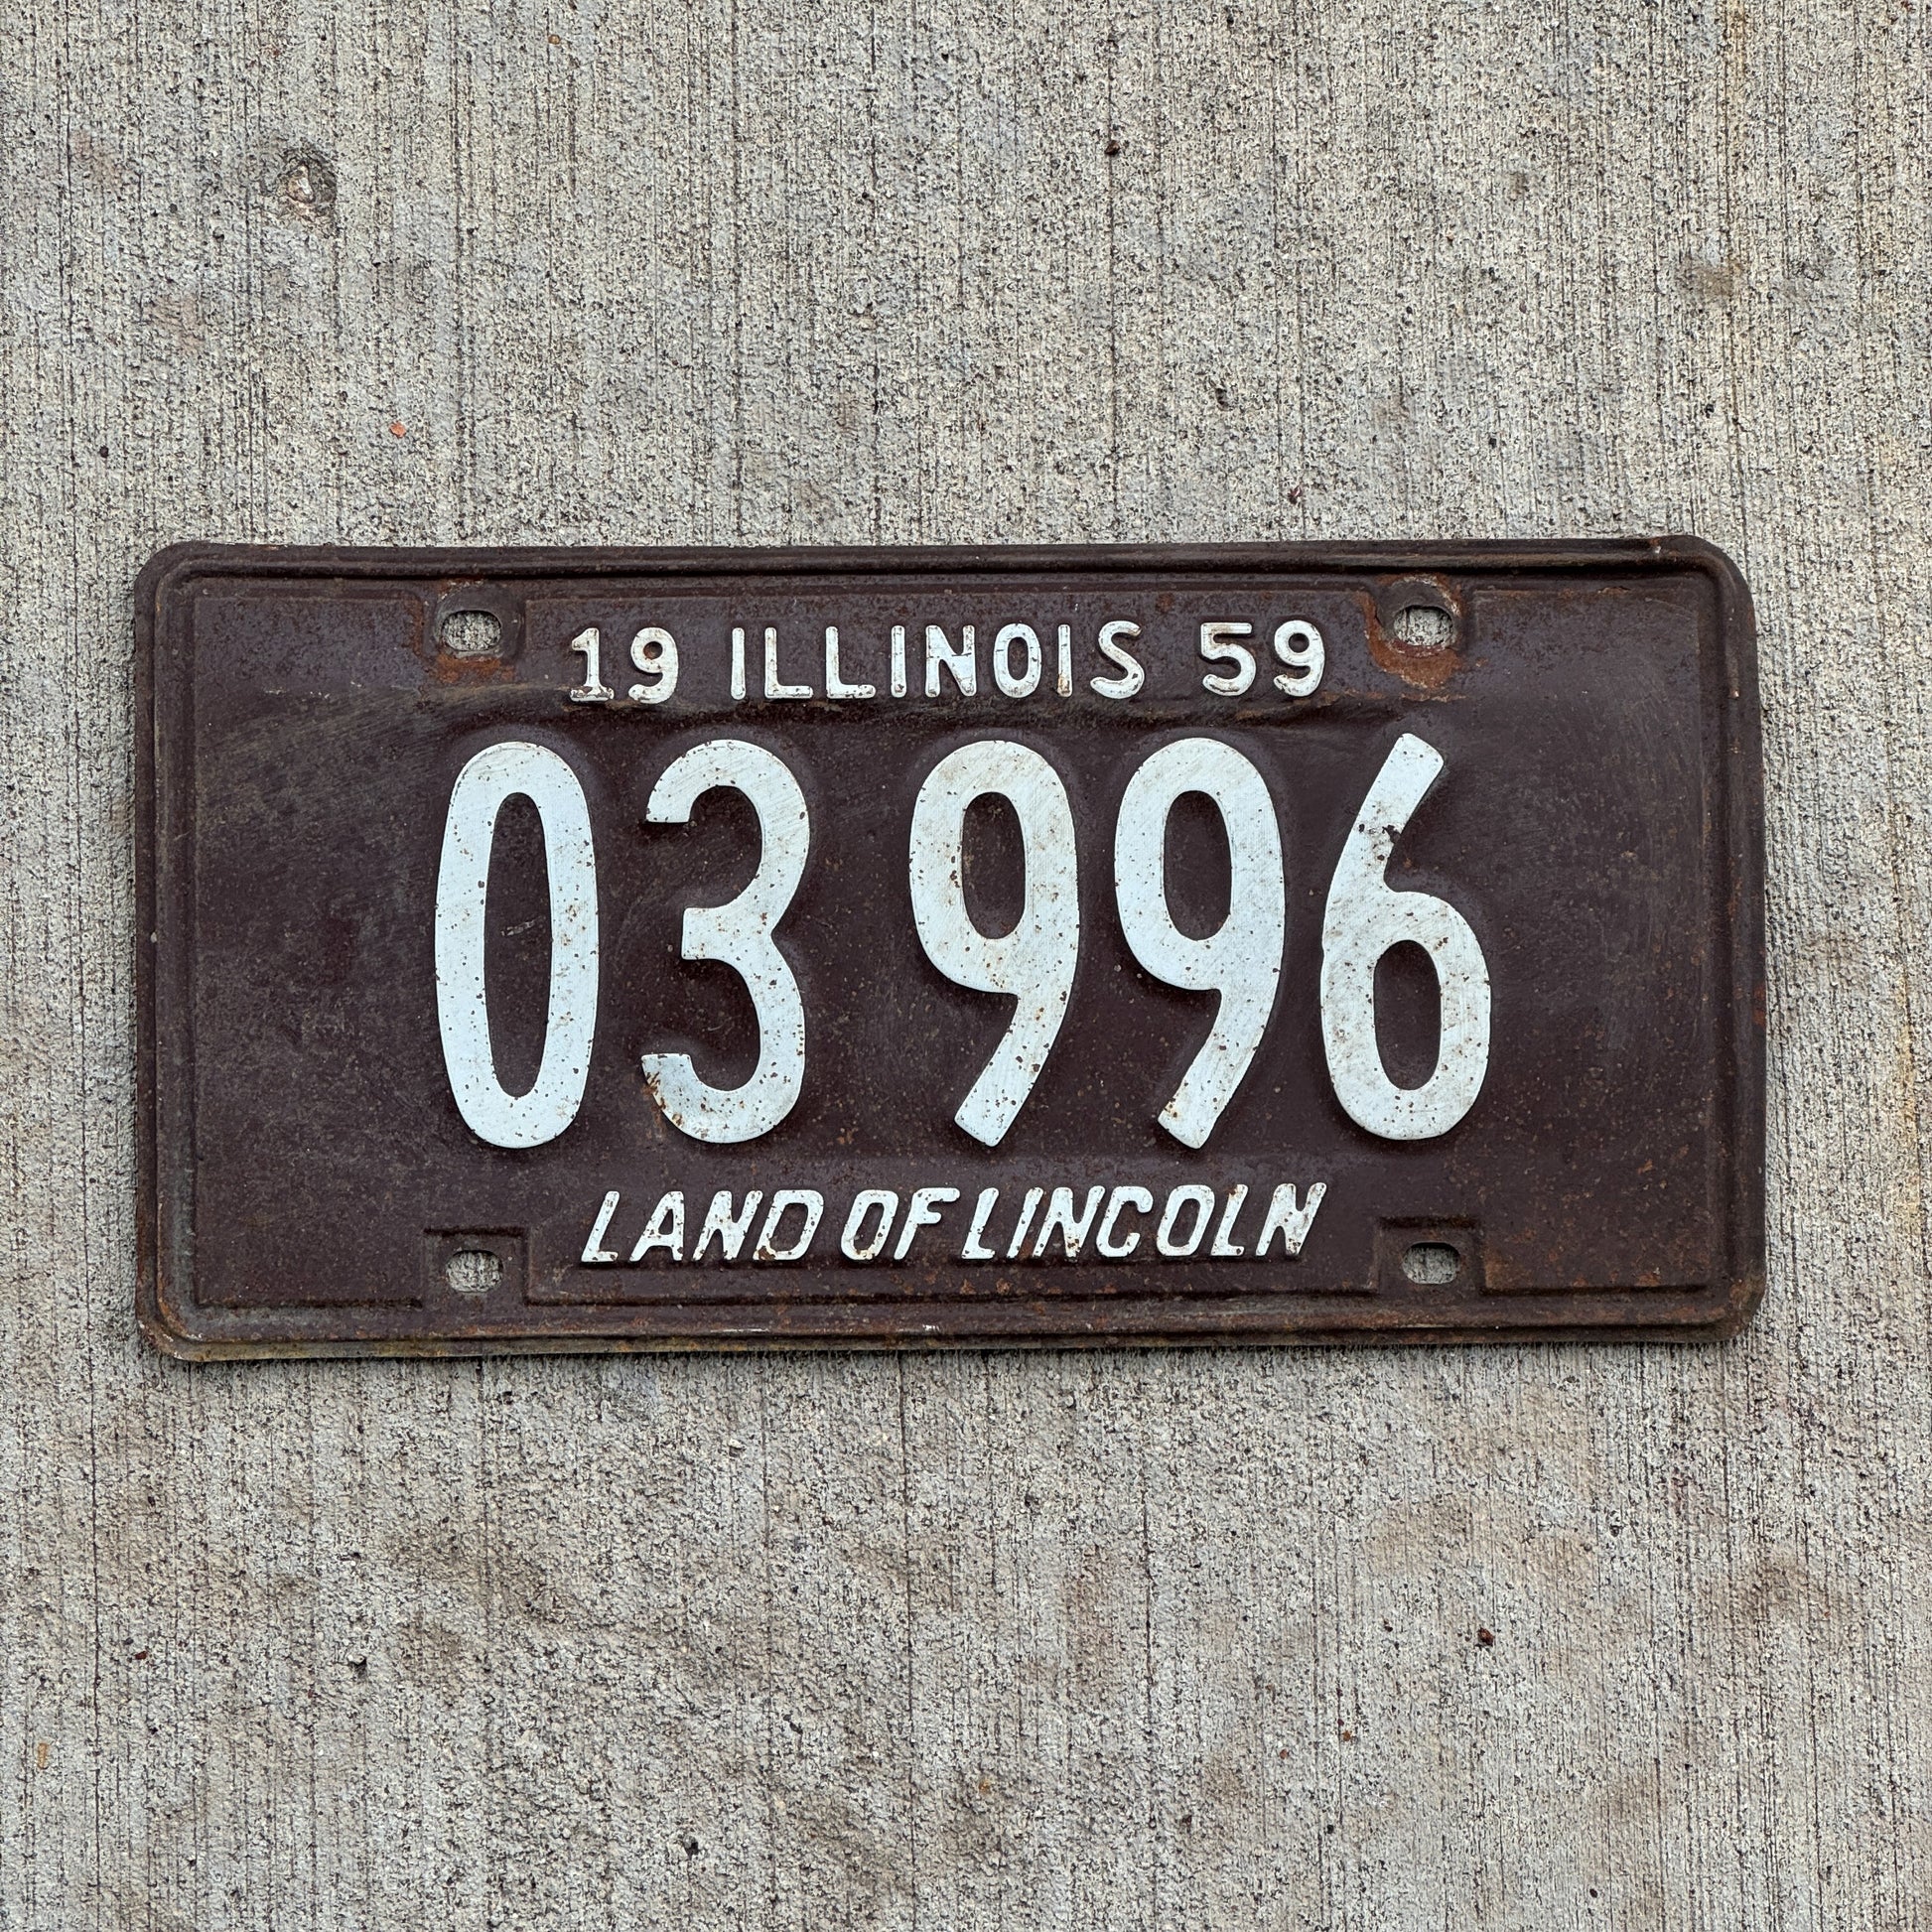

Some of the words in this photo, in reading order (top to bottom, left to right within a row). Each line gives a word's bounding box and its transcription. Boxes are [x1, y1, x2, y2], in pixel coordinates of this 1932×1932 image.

[570, 627, 679, 703] 19
[730, 621, 1146, 702] ILLINOIS
[1199, 621, 1325, 699] 59
[435, 738, 811, 1149] 03
[908, 734, 1491, 1150] 996
[581, 1189, 824, 1263] LAND
[840, 1186, 961, 1261] OF
[961, 1181, 1327, 1259] LINCOLN
